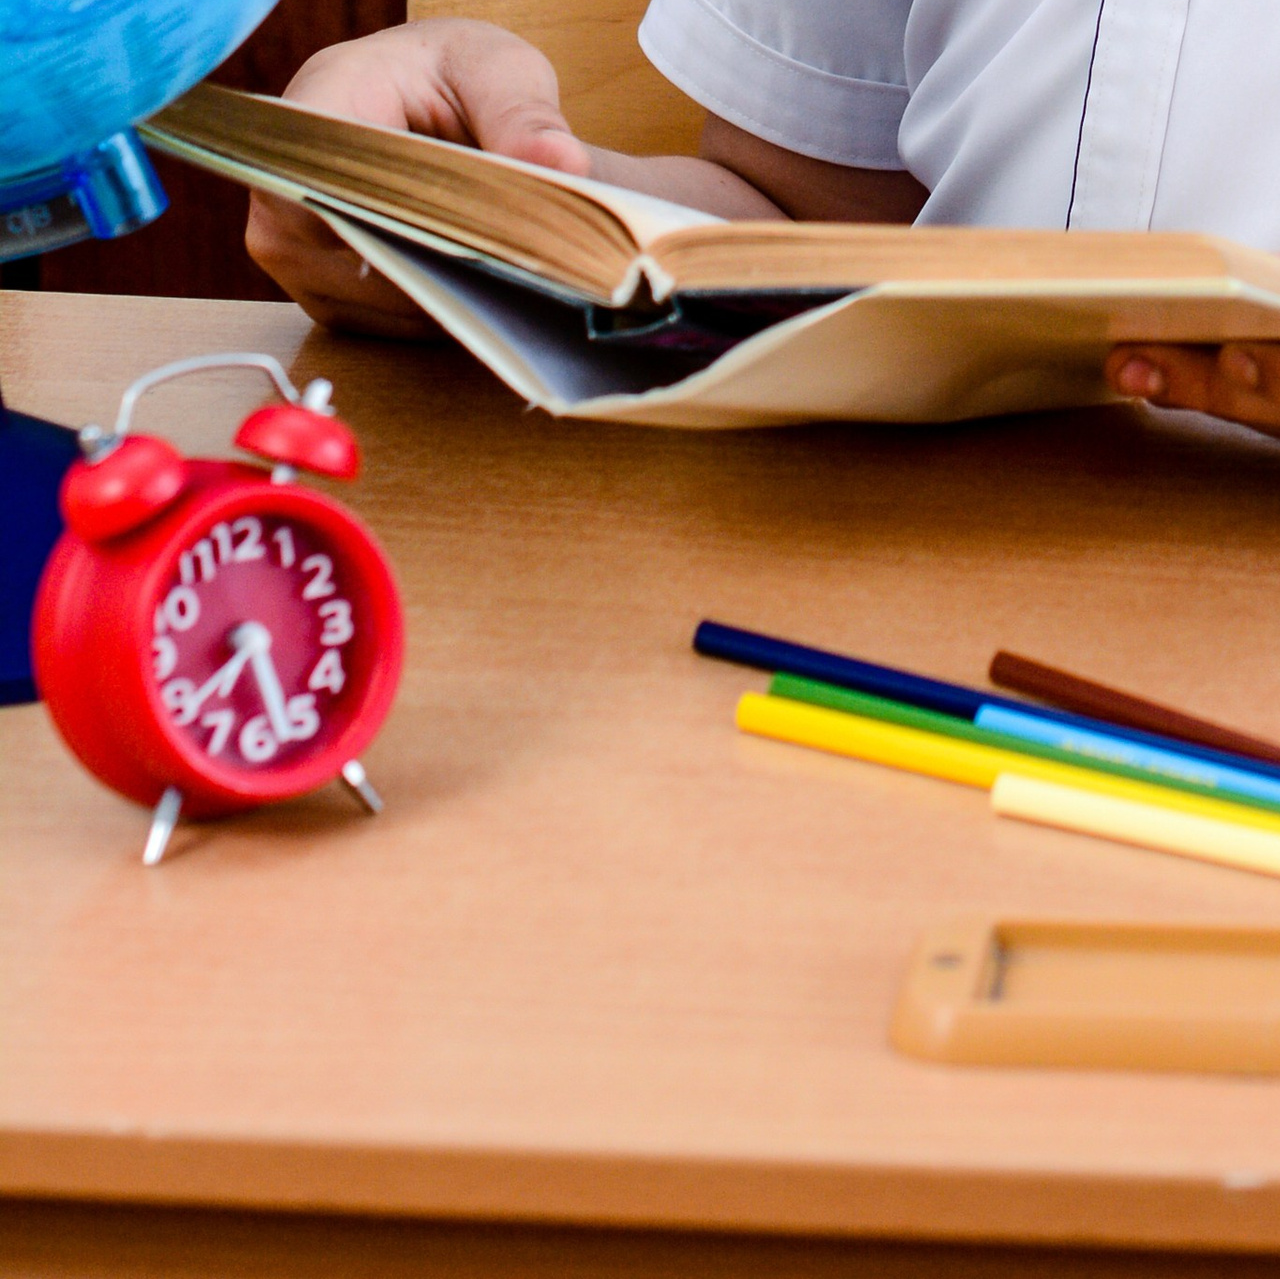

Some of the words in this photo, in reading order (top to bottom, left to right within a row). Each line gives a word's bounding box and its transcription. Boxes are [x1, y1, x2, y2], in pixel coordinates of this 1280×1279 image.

[179, 538, 216, 585] 11
[211, 516, 266, 565] 12
[272, 527, 295, 568] 1
[302, 554, 337, 601] 2
[318, 599, 354, 647] 3
[308, 649, 346, 695] 4
[201, 709, 236, 757] 7
[239, 713, 280, 762] 6
